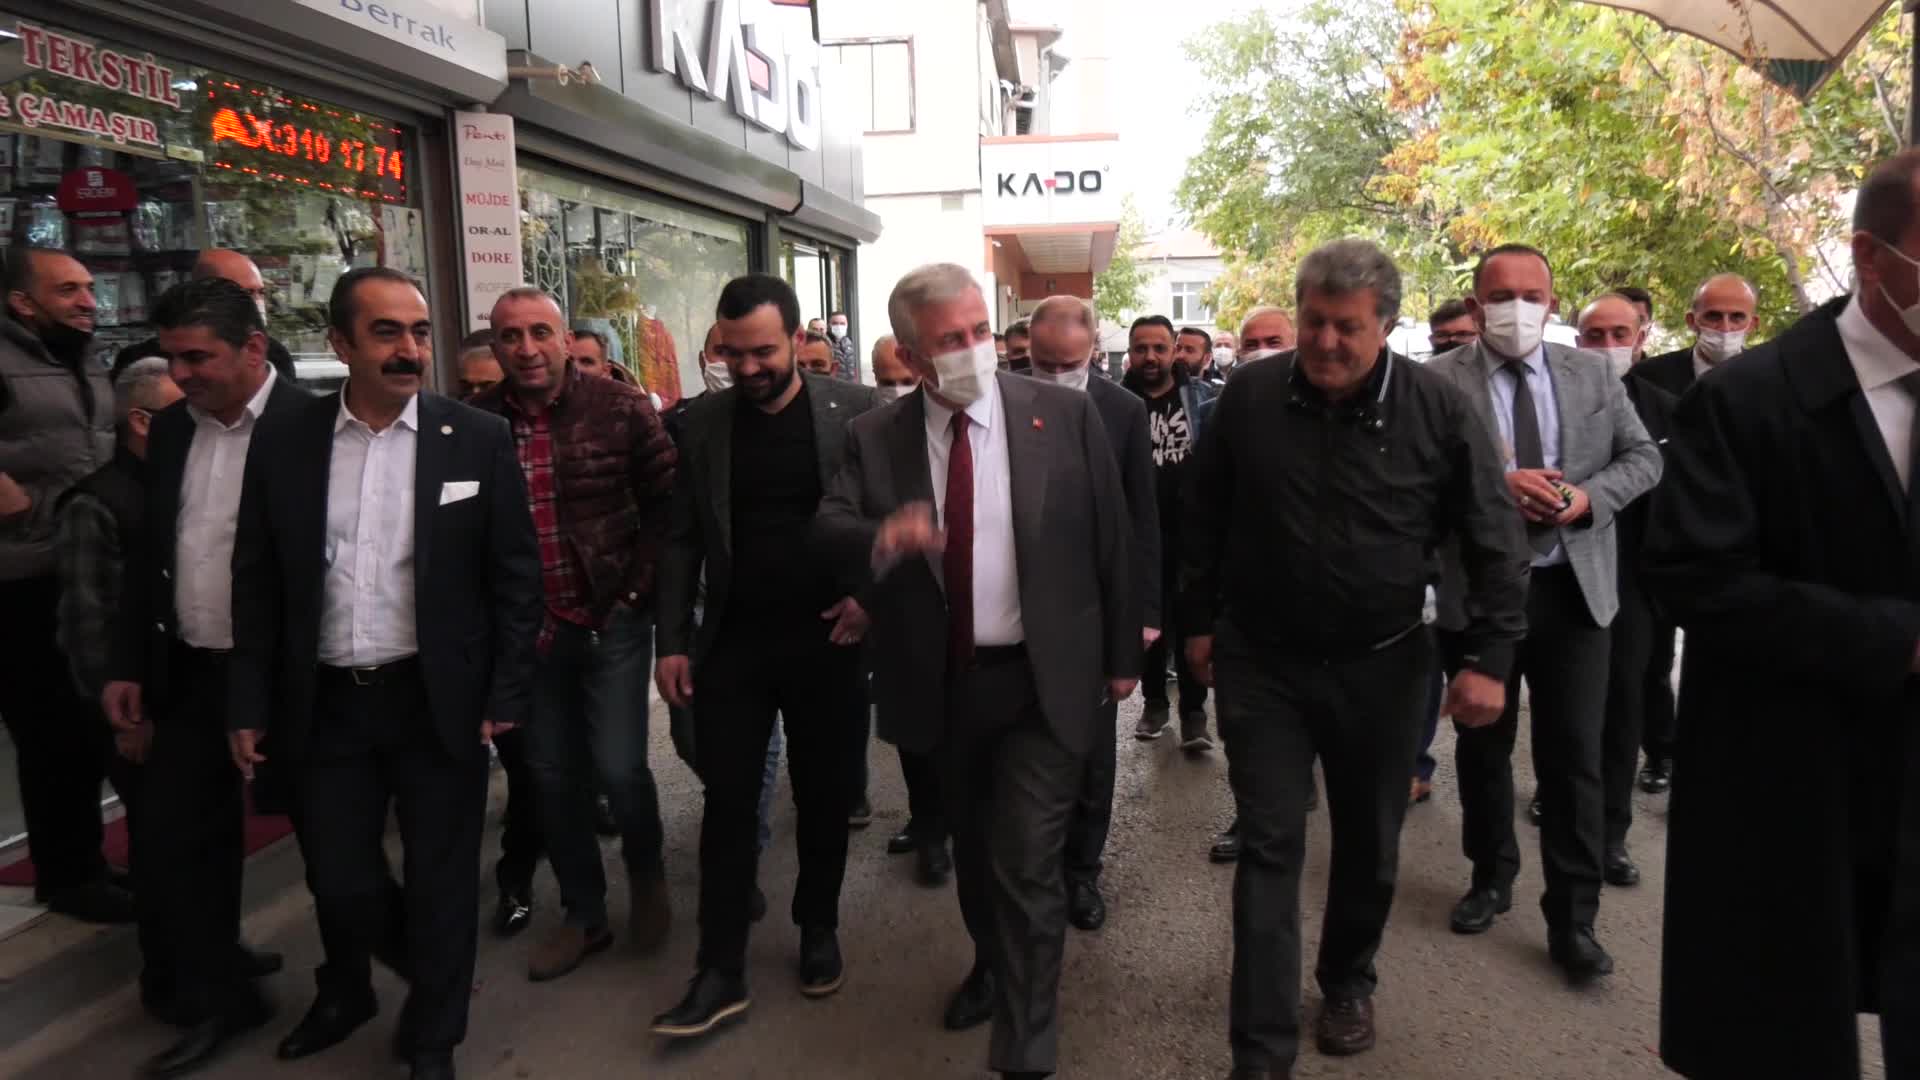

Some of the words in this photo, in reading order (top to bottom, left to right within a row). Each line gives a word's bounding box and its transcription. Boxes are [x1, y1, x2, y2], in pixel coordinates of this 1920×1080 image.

[16, 21, 181, 109] TEKSTİL
[17, 93, 160, 145] ÇAMAŞIR
[463, 124, 507, 141] Penti
[340, 138, 365, 173] 17
[997, 170, 1102, 197] KADO
[465, 192, 512, 207] MÜJDE
[468, 226, 512, 237] OR-AL
[471, 251, 513, 264] DORE
